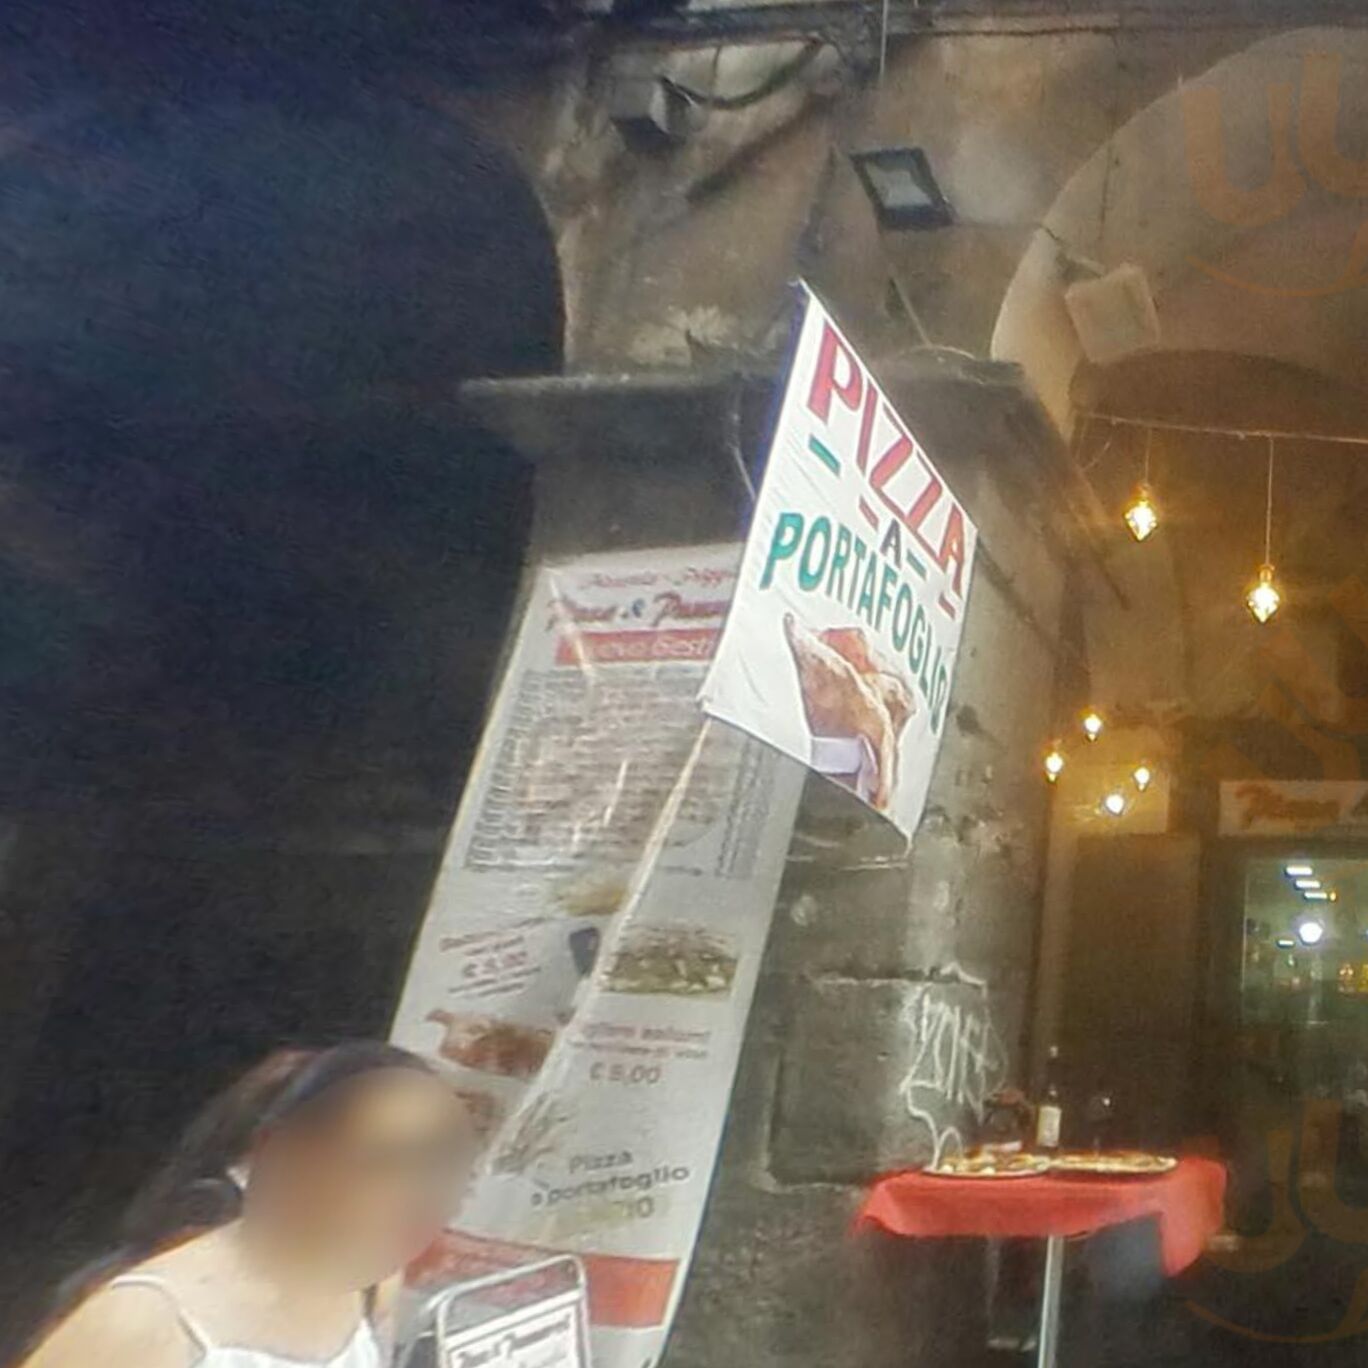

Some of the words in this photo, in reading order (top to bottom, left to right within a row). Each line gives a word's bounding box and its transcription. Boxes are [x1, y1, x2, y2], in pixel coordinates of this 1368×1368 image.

[806, 318, 966, 602] PIZZA
[879, 517, 903, 567] A
[758, 511, 950, 736] PORTAFOGLIO
